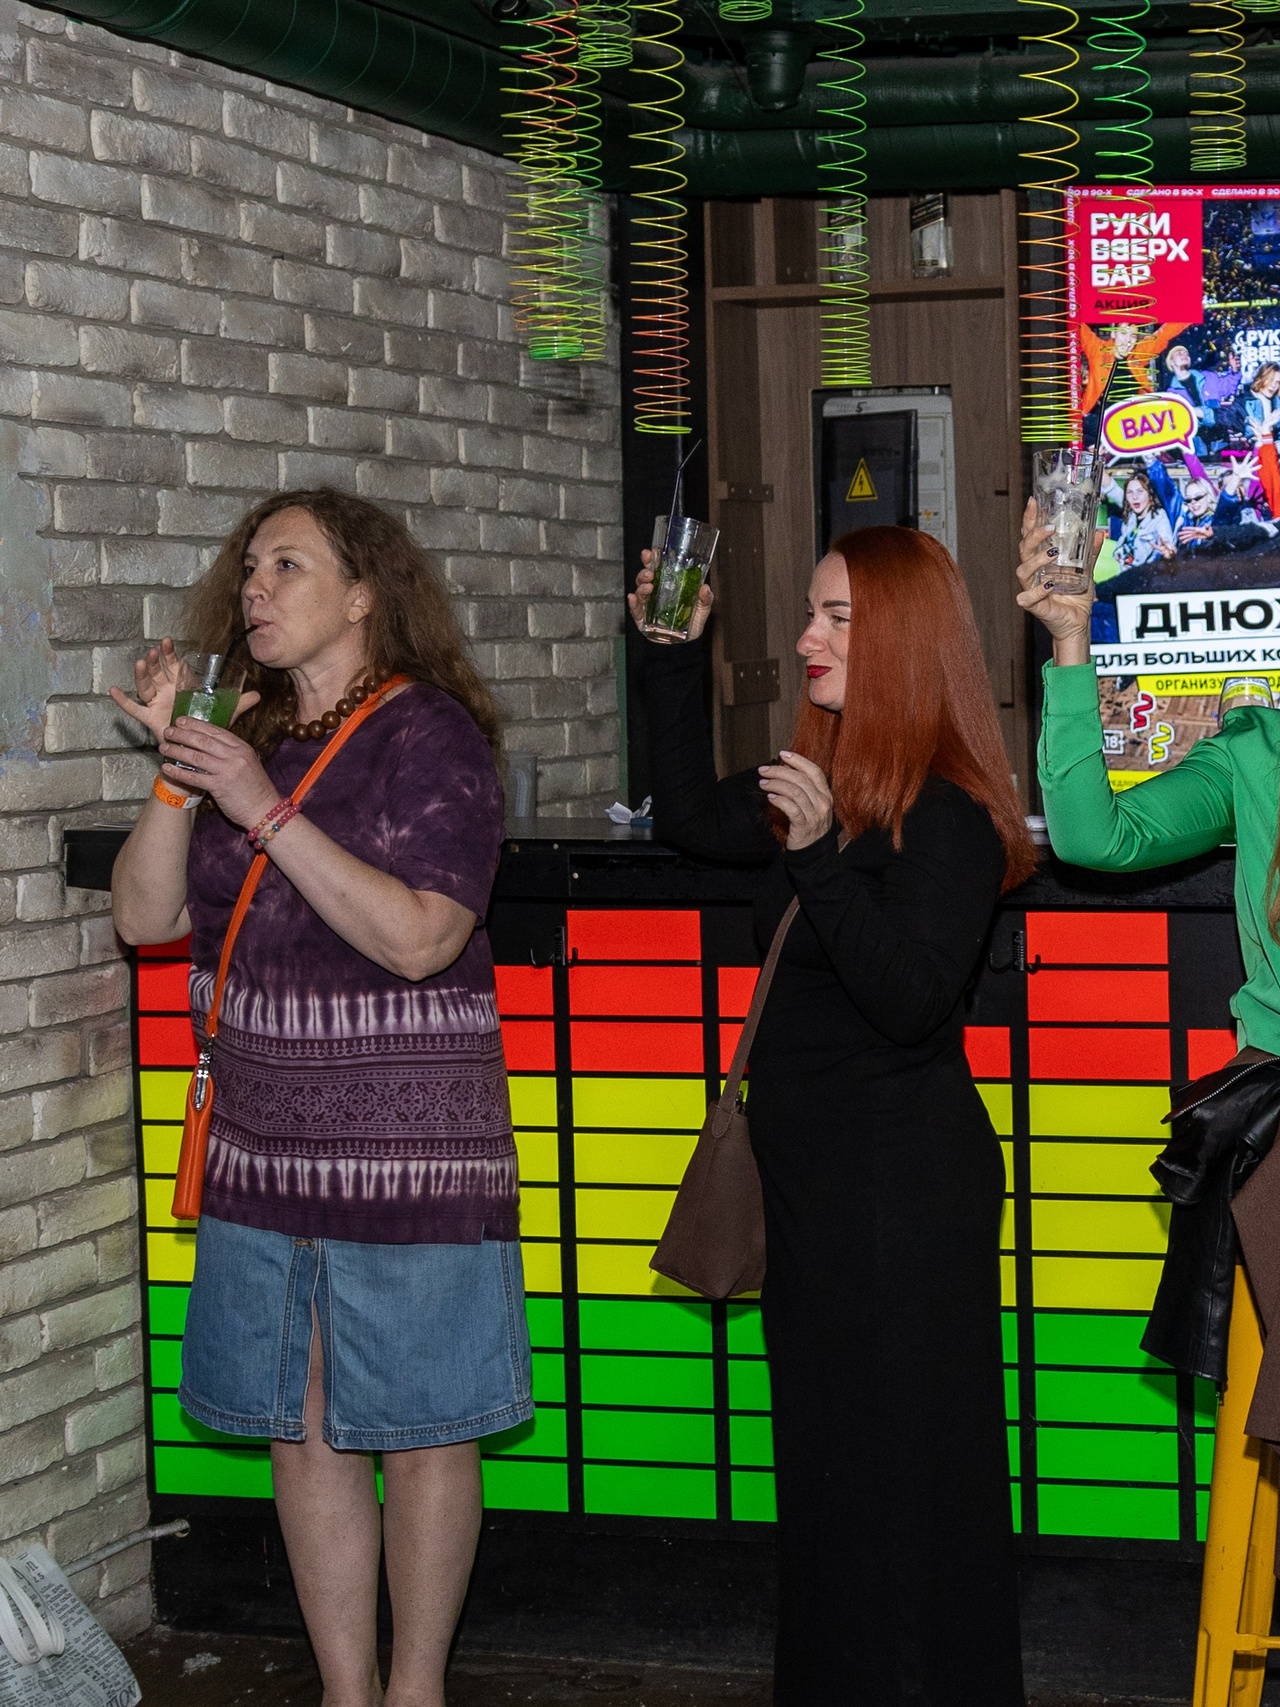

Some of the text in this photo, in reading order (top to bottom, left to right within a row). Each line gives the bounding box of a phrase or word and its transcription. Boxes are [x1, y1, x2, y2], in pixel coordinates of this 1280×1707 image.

[1126, 188, 1171, 197] СДЕЛАНО
[1181, 188, 1203, 197] 90-Х
[1211, 188, 1257, 196] СДЕЛАНО
[1258, 188, 1265, 196] В
[1090, 212, 1171, 236] РУКИ
[1090, 238, 1190, 262] ВВЕРХ
[1091, 263, 1152, 287] БАР
[1094, 299, 1151, 309] АКЦИЯ
[1120, 409, 1177, 440] ВАУ!
[1096, 652, 1138, 668] ДЛЯ
[1144, 648, 1257, 666] БОЛЬШИХ
[1105, 735, 1126, 749] 18+
